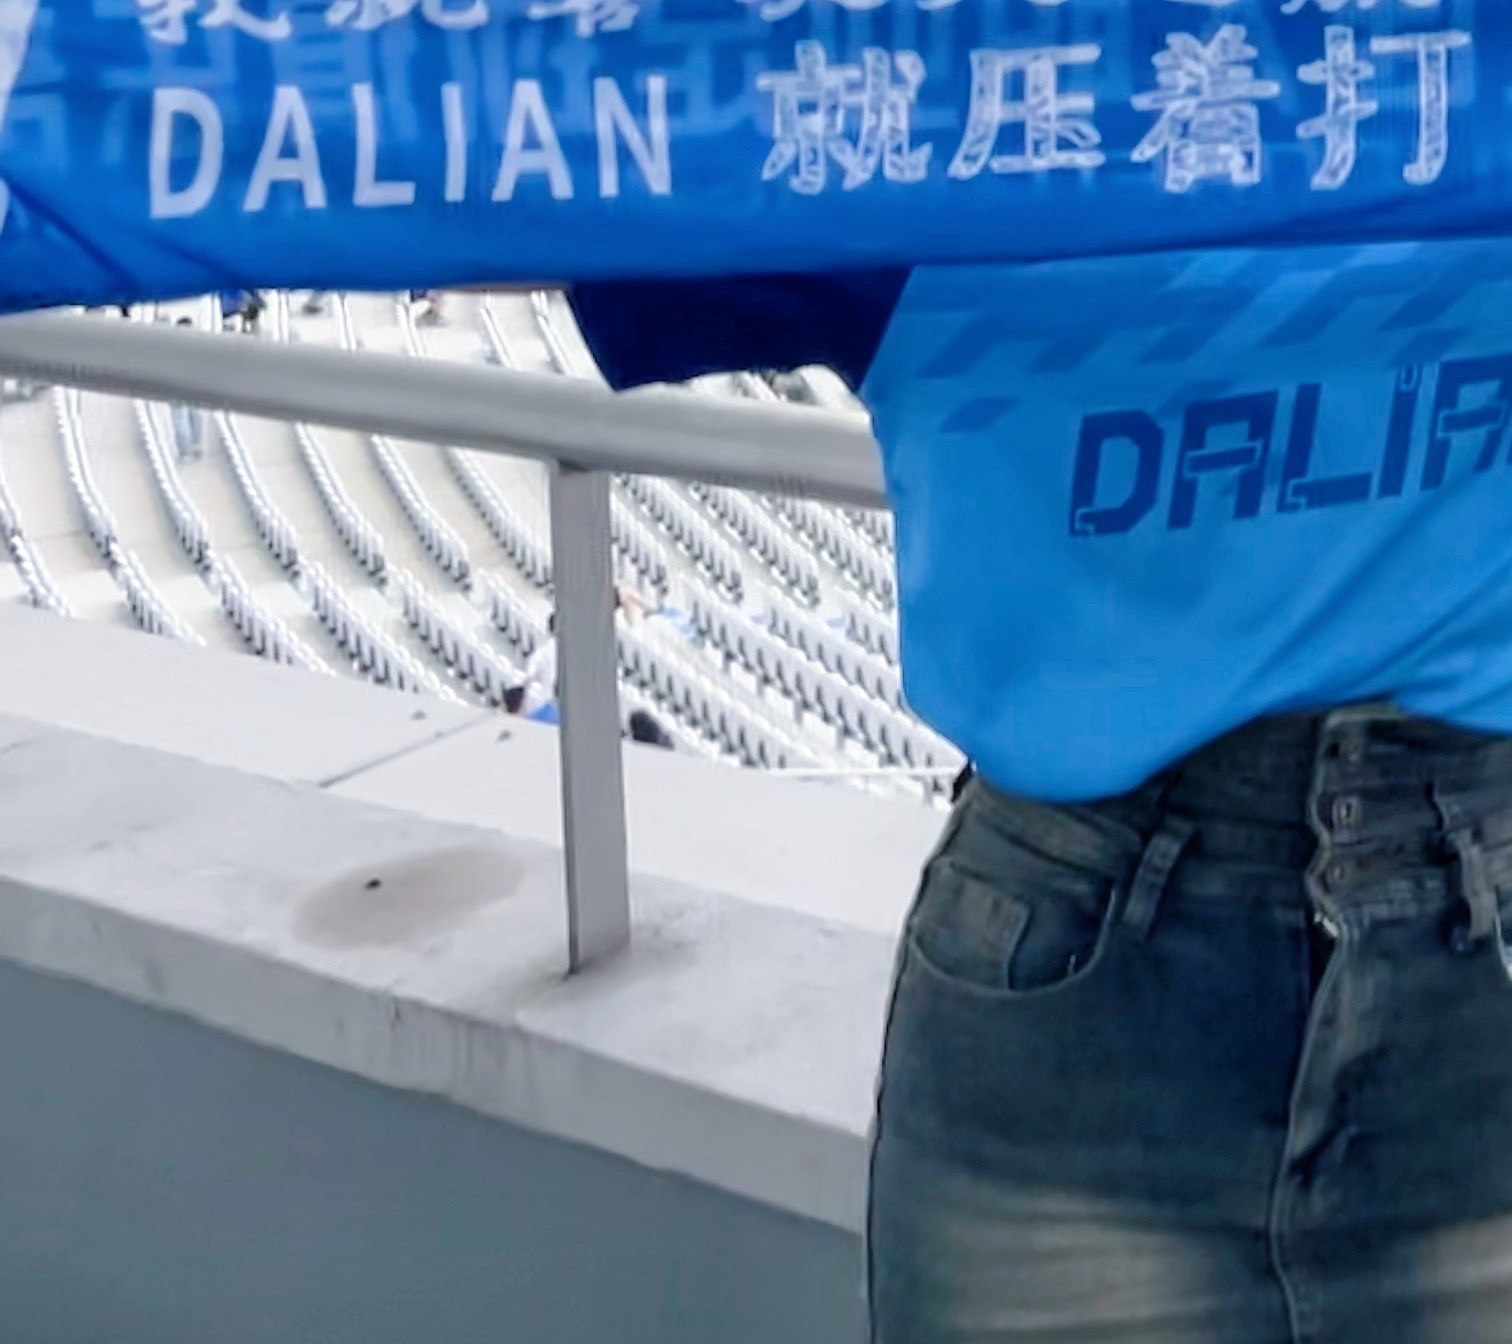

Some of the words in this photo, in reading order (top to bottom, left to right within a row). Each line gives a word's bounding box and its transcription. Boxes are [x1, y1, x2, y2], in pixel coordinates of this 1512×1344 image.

[148, 75, 673, 220] DALIAN
[755, 23, 1473, 195] 就压着打
